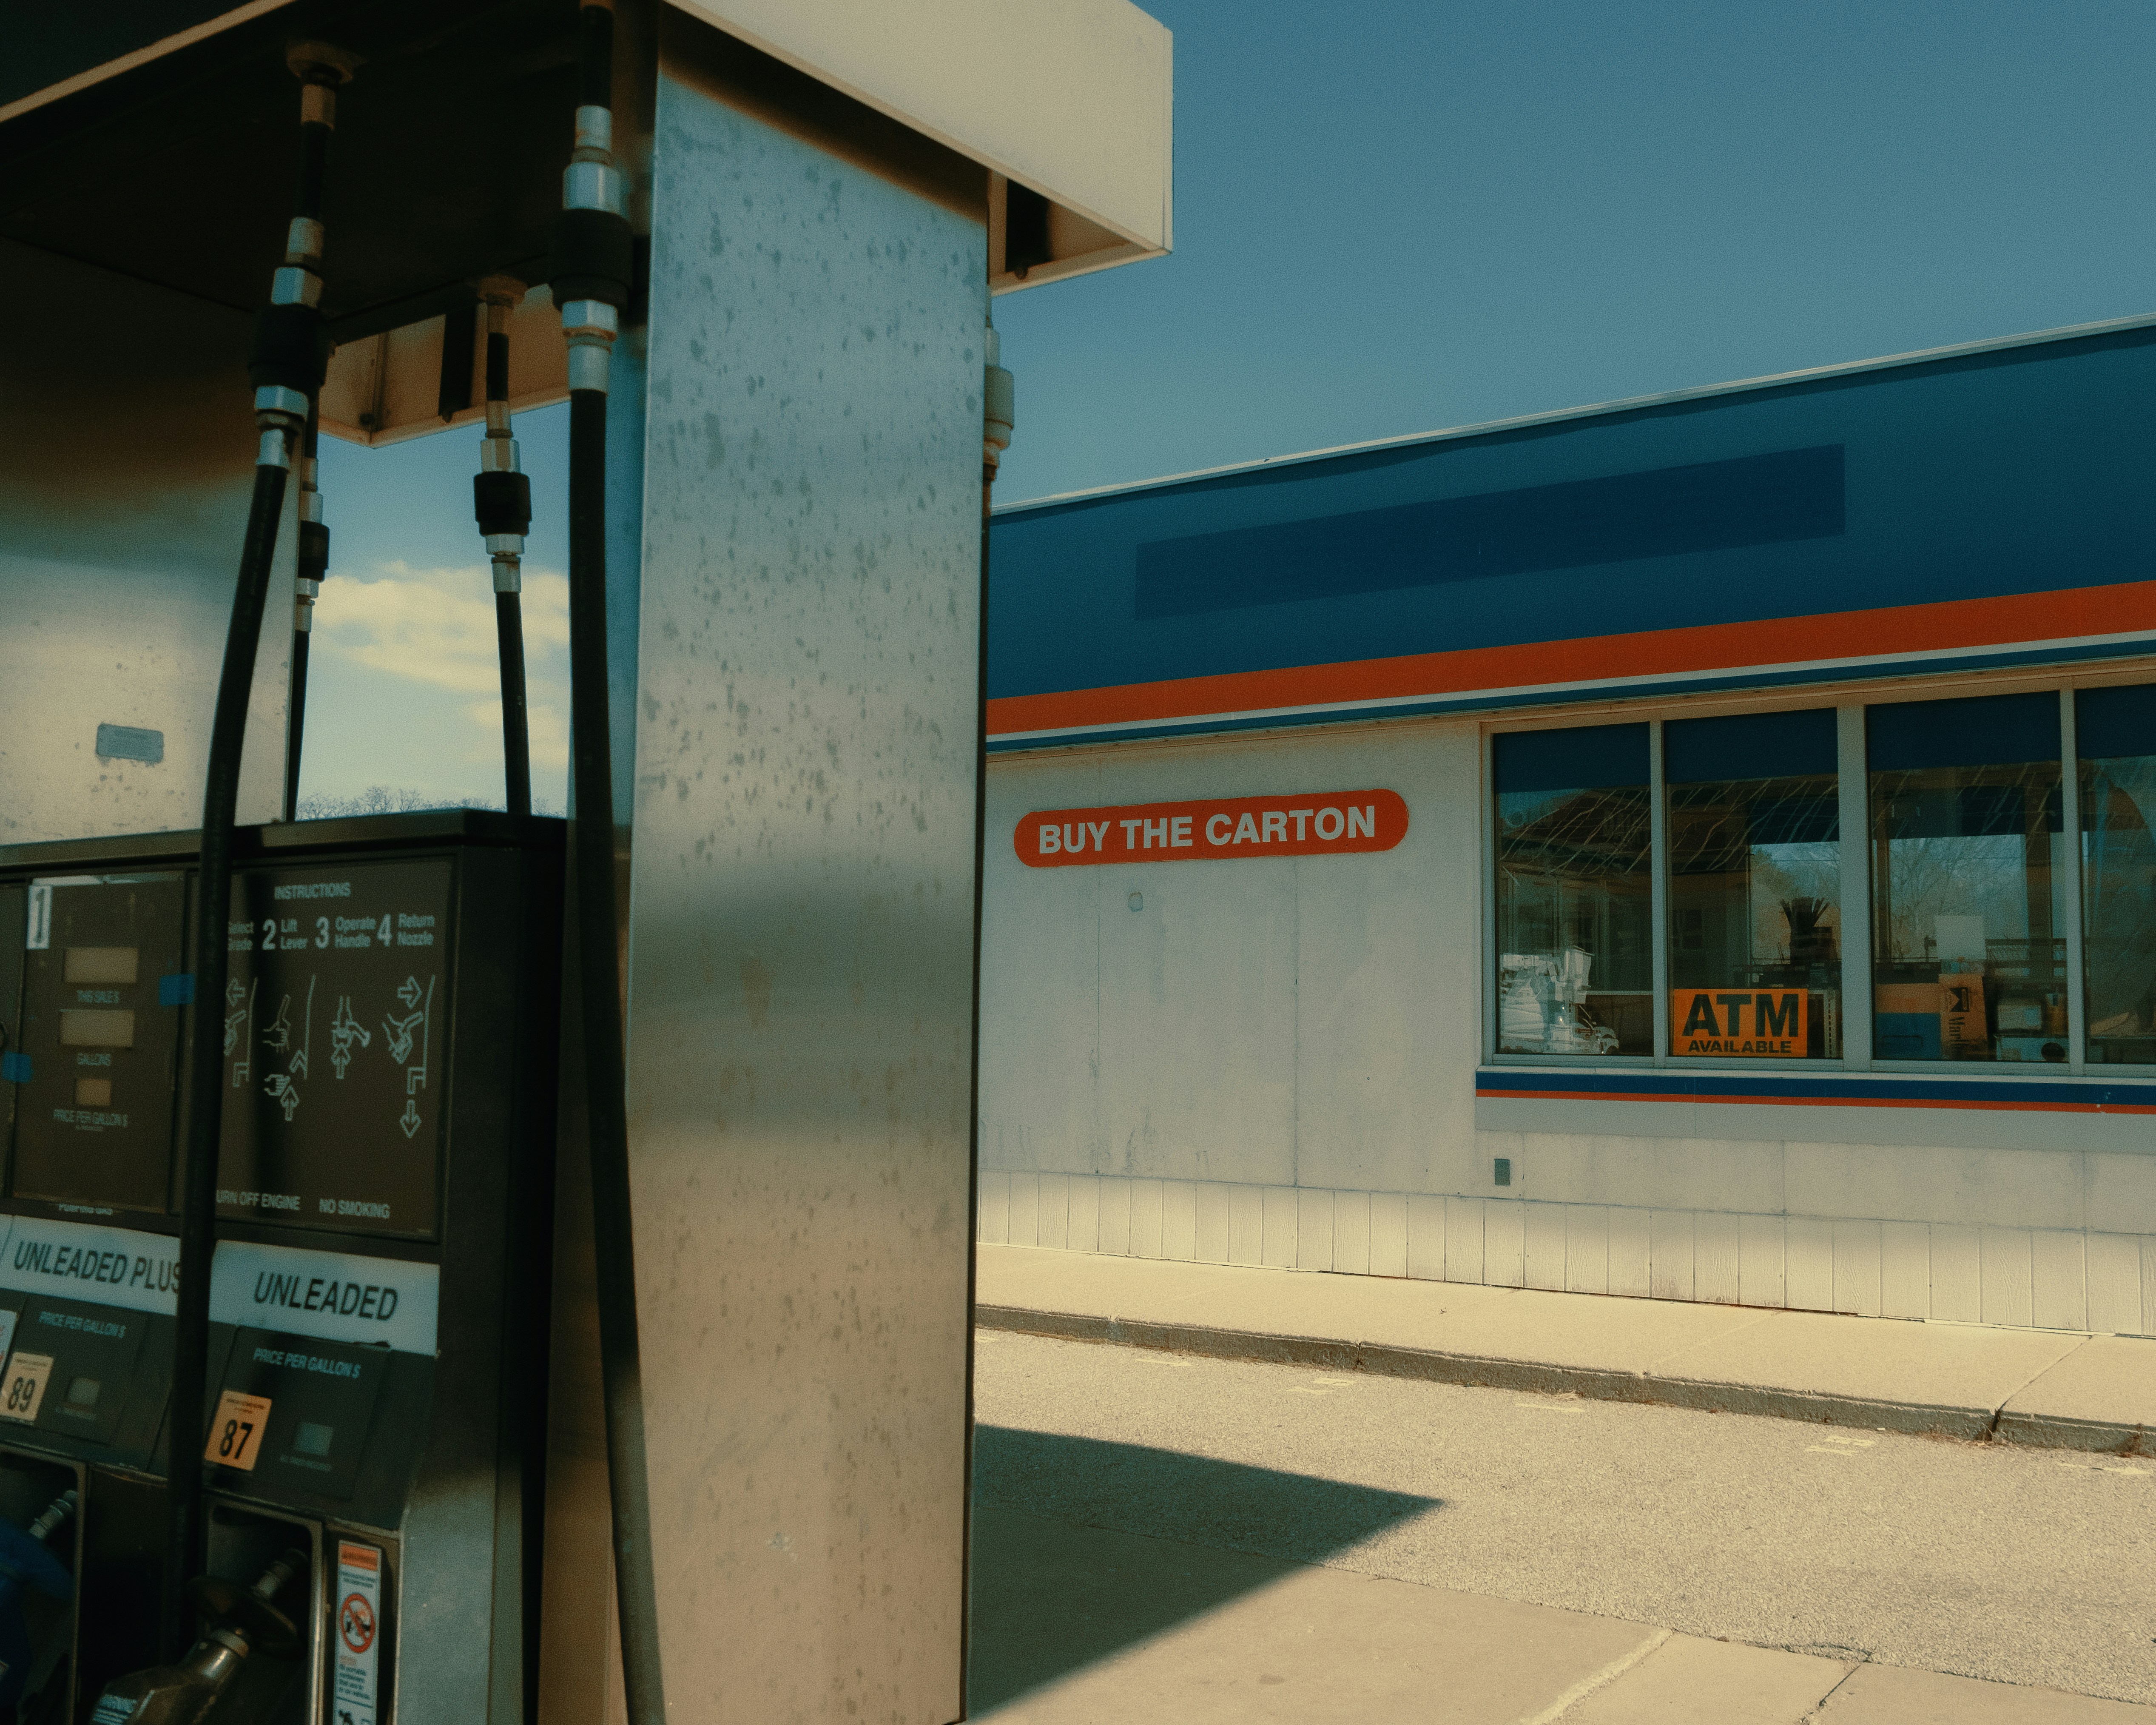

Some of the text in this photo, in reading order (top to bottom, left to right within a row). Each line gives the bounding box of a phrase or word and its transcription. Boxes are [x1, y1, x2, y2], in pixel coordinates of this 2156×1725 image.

[1039, 805, 1375, 854] BUY THE CARTON
[274, 882, 351, 900] INSTRUCTIONS
[281, 918, 298, 933] Lift
[335, 916, 376, 933] Operate
[377, 913, 393, 947] 4
[398, 913, 435, 928] Return
[262, 918, 277, 950] 2
[280, 936, 308, 950] Lever
[315, 916, 330, 949] 3
[334, 934, 371, 948] Handle
[397, 931, 434, 946] Nozzle
[1682, 993, 1799, 1037] ATM
[1688, 1040, 1792, 1053] AVAILABLE
[77, 1053, 111, 1066] GALLONS
[216, 1190, 301, 1211] URN OFF ENGINE
[319, 1198, 390, 1219] NO SMOKING
[14, 1241, 181, 1294] UNLEADED PLUS
[254, 1271, 398, 1321] UNLEADED
[38, 1311, 65, 1328] PRICE
[64, 1315, 83, 1330] PER
[82, 1318, 119, 1337] GALLON
[253, 1347, 284, 1365] PRICE
[284, 1352, 307, 1369] PER
[307, 1356, 353, 1377] GALLON
[7, 1376, 36, 1412] 89
[219, 1419, 254, 1459] 87
